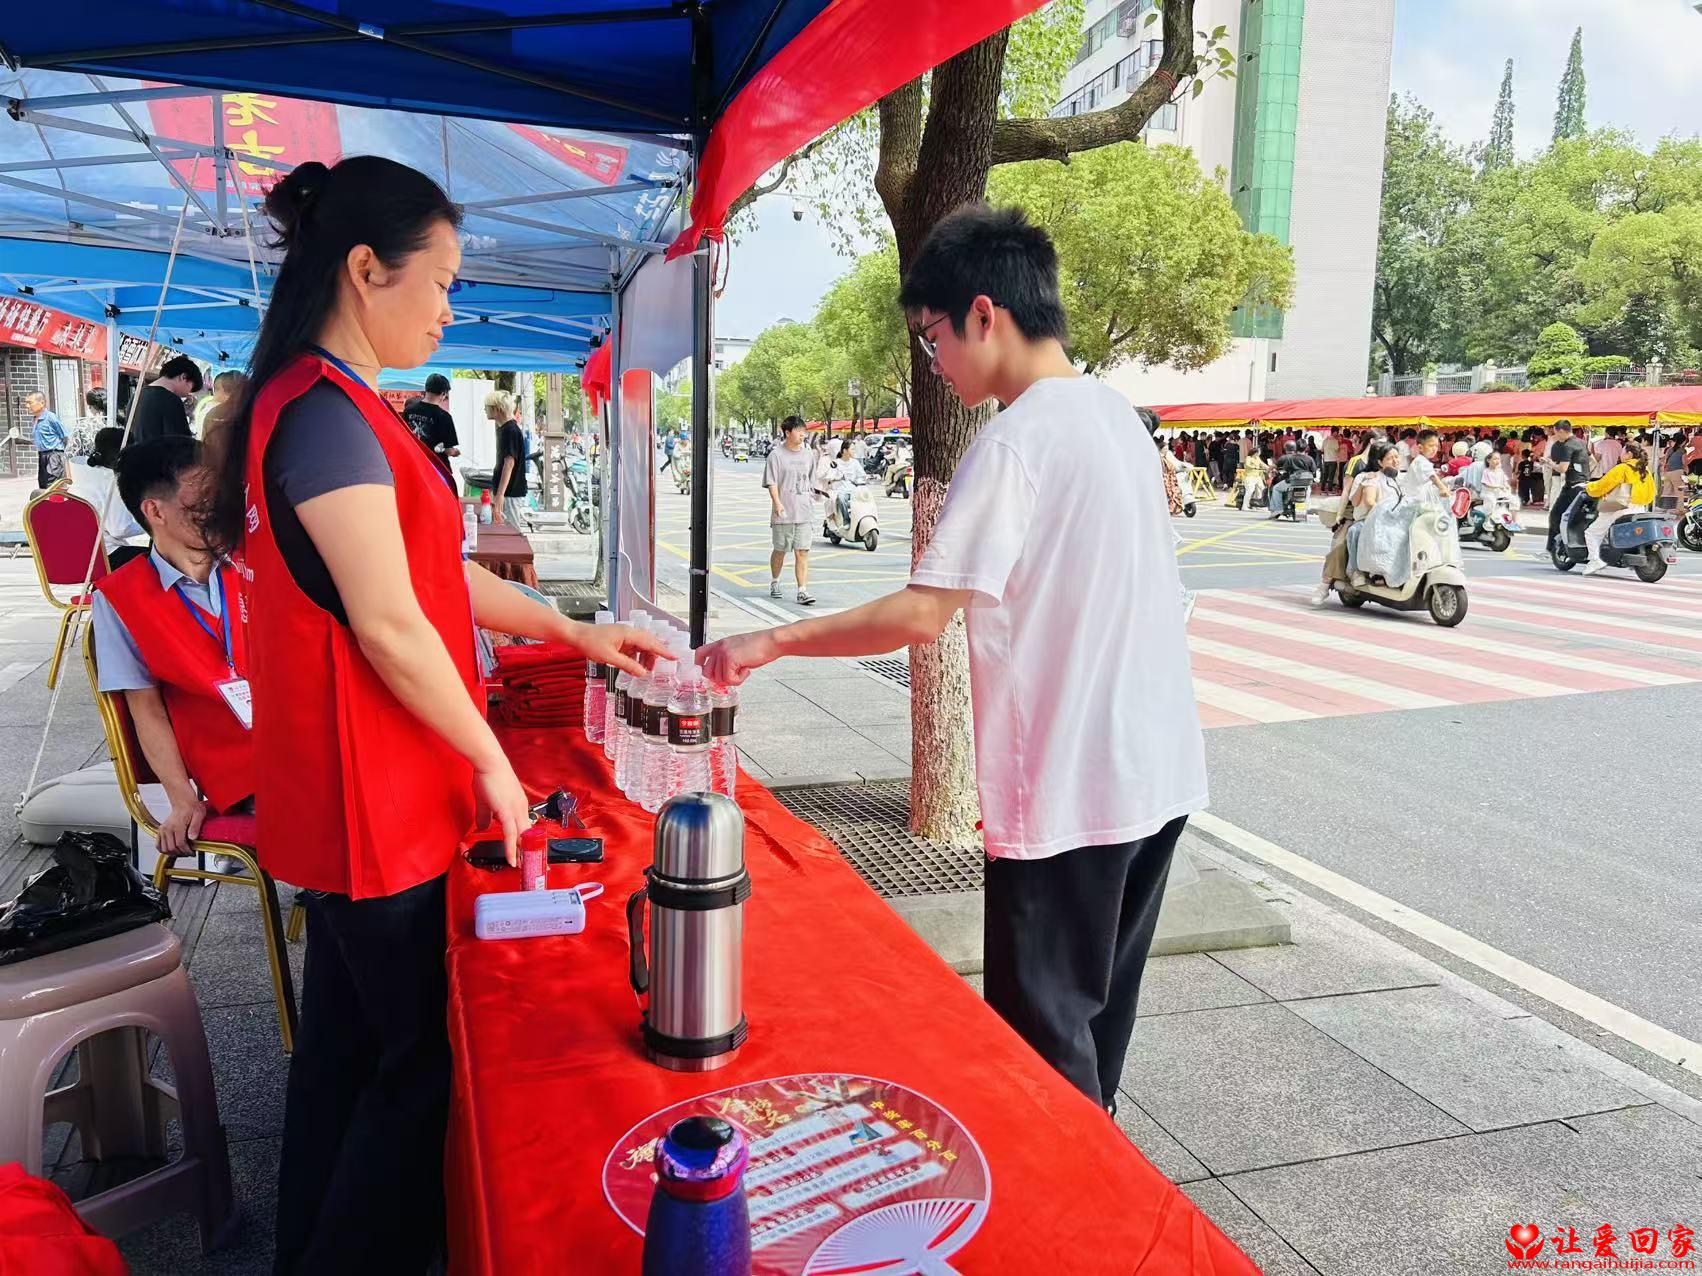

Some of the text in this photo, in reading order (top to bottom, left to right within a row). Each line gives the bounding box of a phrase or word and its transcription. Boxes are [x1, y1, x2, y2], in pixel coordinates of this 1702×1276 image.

[870, 1100, 958, 1162] 中奖率百分百
